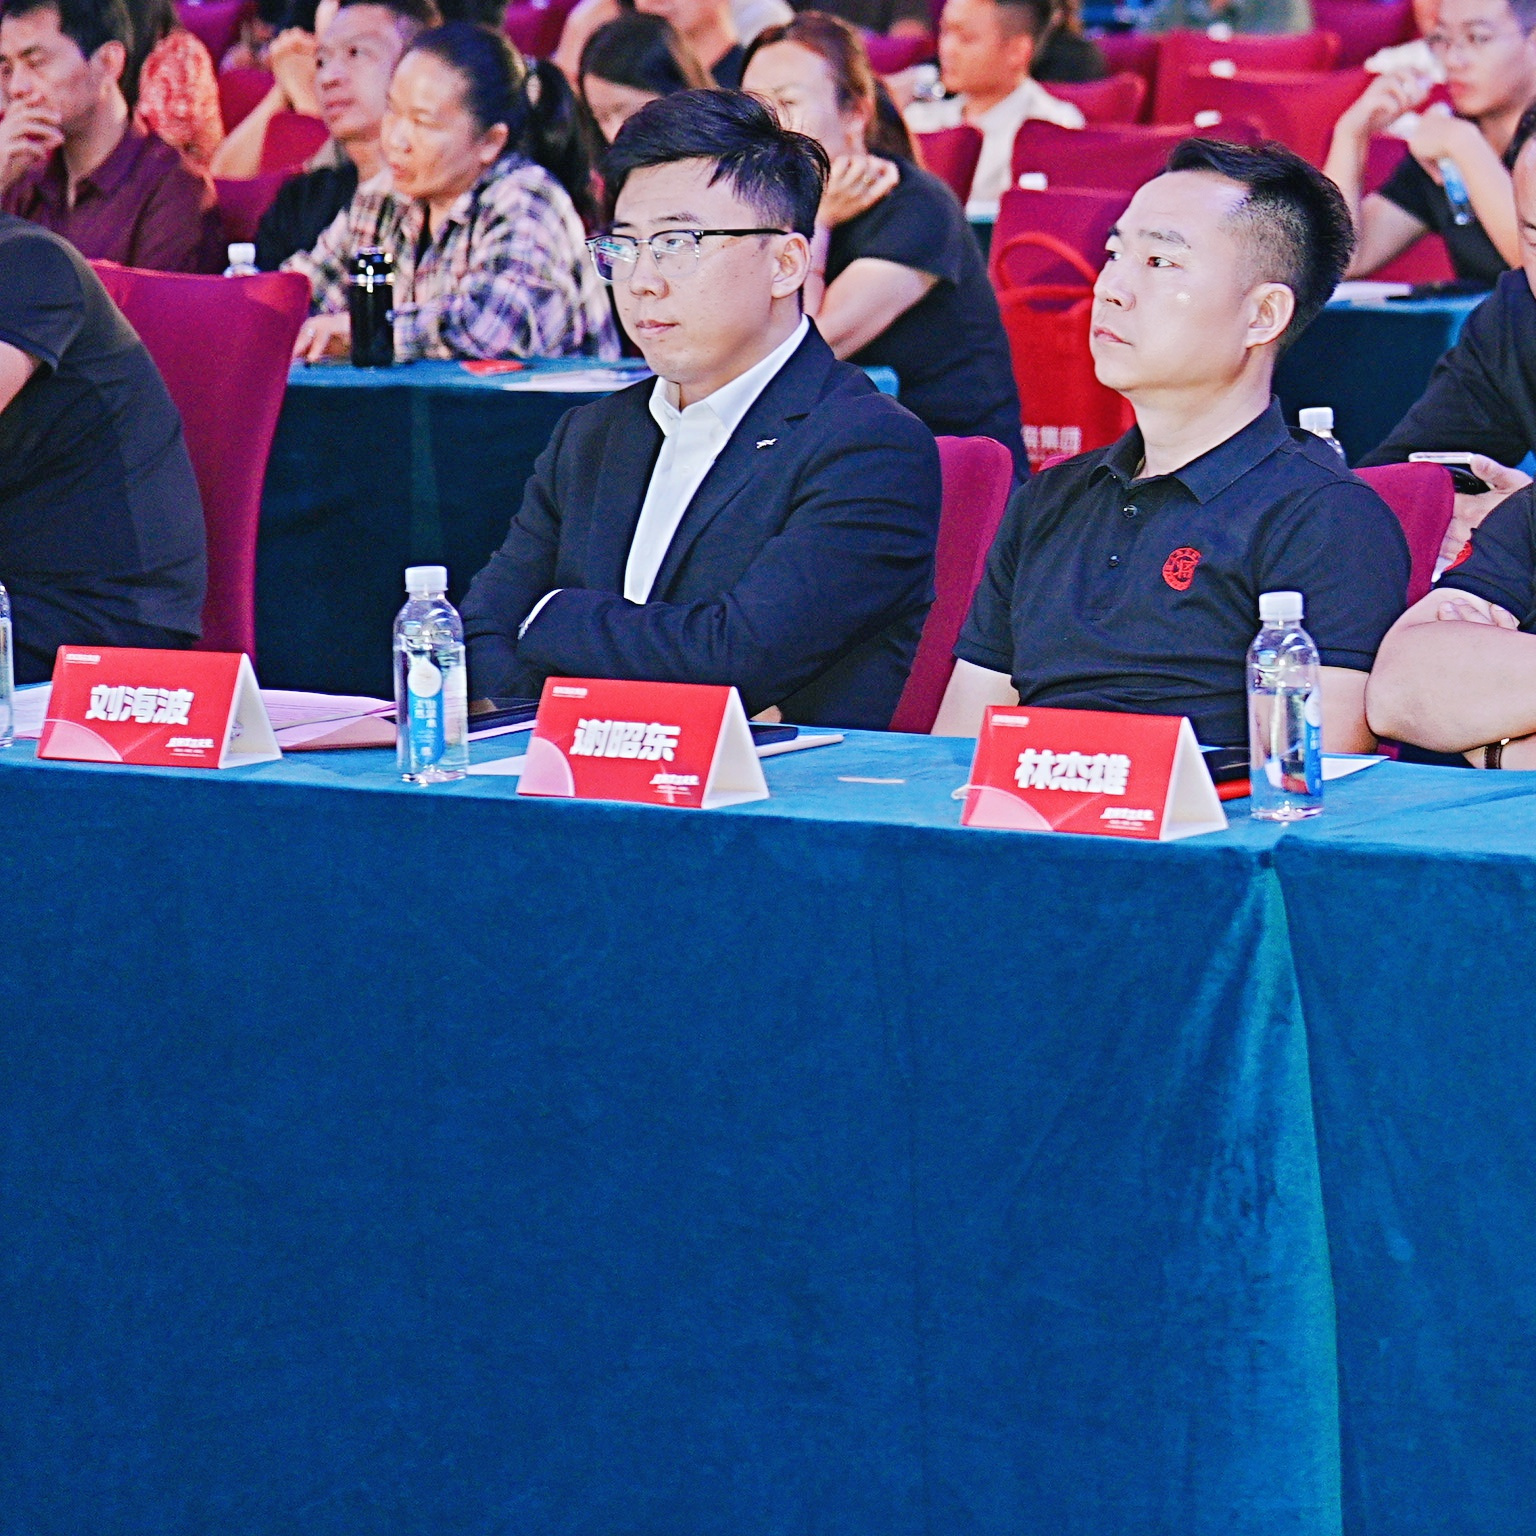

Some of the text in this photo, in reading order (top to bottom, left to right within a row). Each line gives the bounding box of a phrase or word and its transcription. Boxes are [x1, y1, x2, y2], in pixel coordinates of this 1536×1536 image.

[85, 684, 195, 726] 刘海波
[569, 718, 681, 762] 谢昭东
[1014, 747, 1132, 796] 林杰雄
